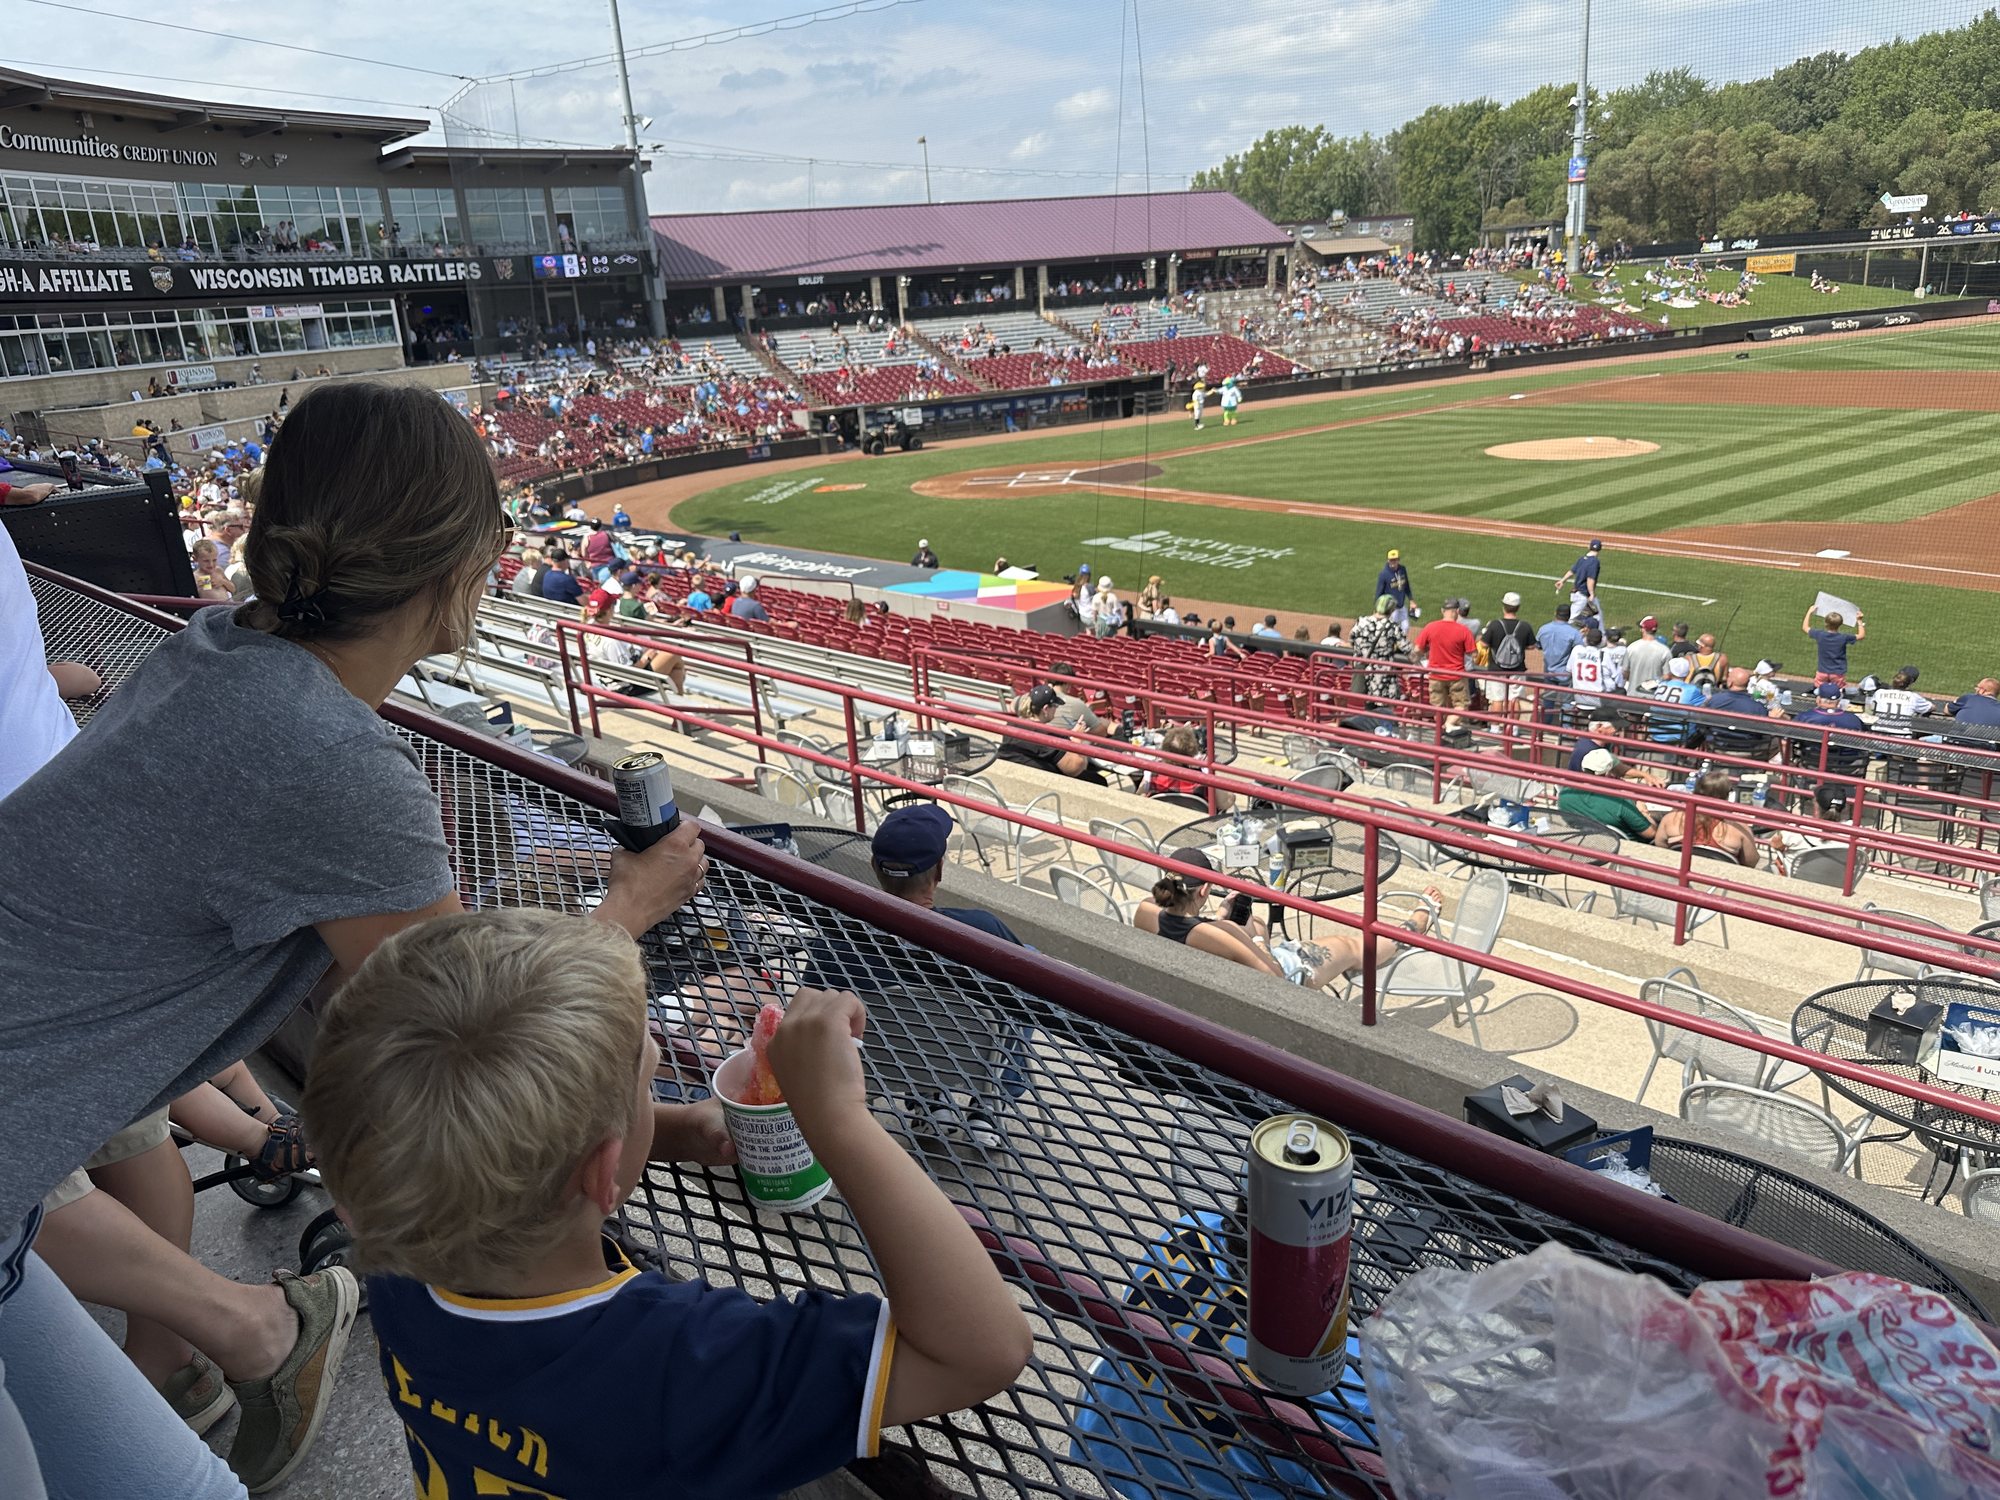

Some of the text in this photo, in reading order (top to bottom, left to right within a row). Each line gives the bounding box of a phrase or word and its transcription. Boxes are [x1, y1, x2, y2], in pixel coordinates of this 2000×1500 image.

[0, 125, 217, 166] Communities CREDIT UNION
[39, 269, 133, 293] AFFILIATE
[190, 267, 304, 290] WISCONSIN
[309, 265, 384, 286] TIMBER
[389, 262, 482, 283] RATTLERS
[798, 276, 824, 285] BOLDT
[1769, 325, 1804, 338] Sure-Dry
[178, 367, 214, 377] JOHNSON
[1577, 662, 1598, 682] 13
[1654, 685, 1682, 704] 26
[744, 1122, 774, 1134] LITTLE
[776, 1135, 792, 1144] GOOD
[745, 1143, 757, 1152] FOR
[758, 1145, 770, 1153] THE
[785, 1163, 796, 1173] FOR
[1298, 1186, 1350, 1221] VIZ
[1310, 1217, 1339, 1230] HARD
